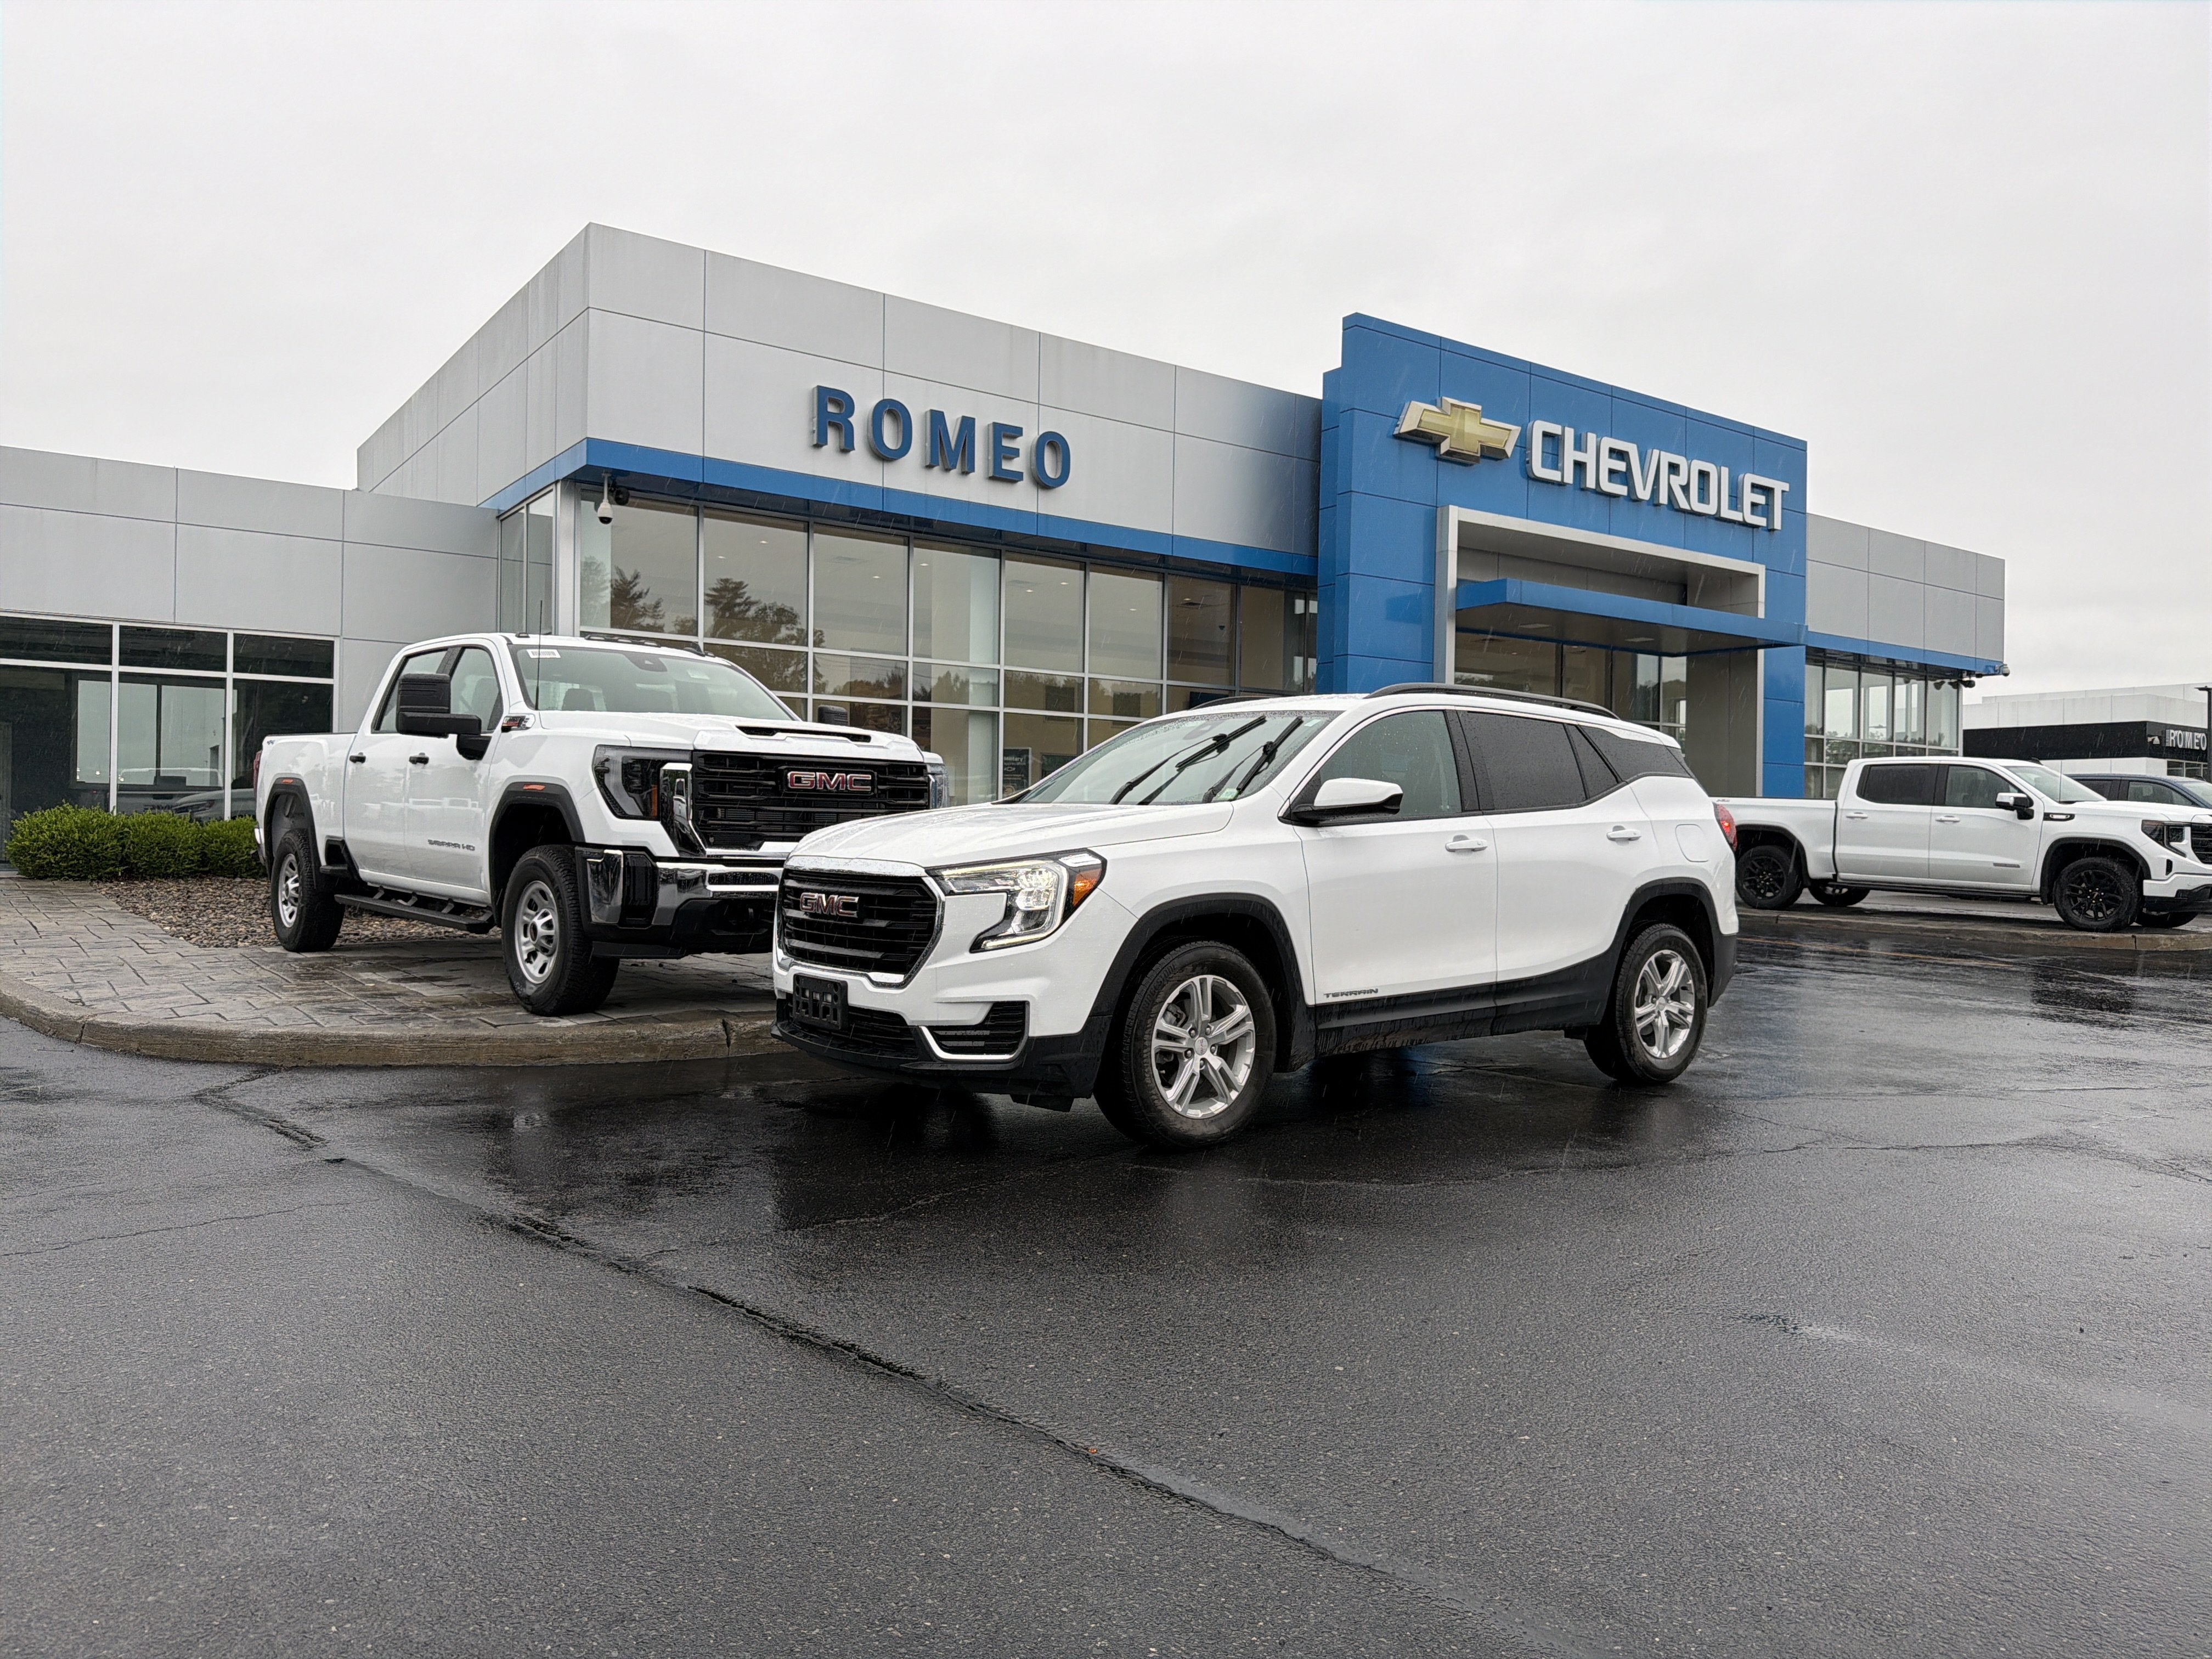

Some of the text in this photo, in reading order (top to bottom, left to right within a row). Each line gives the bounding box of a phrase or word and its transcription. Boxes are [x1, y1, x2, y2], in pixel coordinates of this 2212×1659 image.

[812, 385, 1071, 489] ROMEO
[1526, 420, 1790, 531] CHEVROLET
[2166, 729, 2207, 751] ROMEO
[788, 771, 872, 791] GMC
[799, 892, 860, 918] GMC
[1324, 989, 1378, 998] TERRAIN
